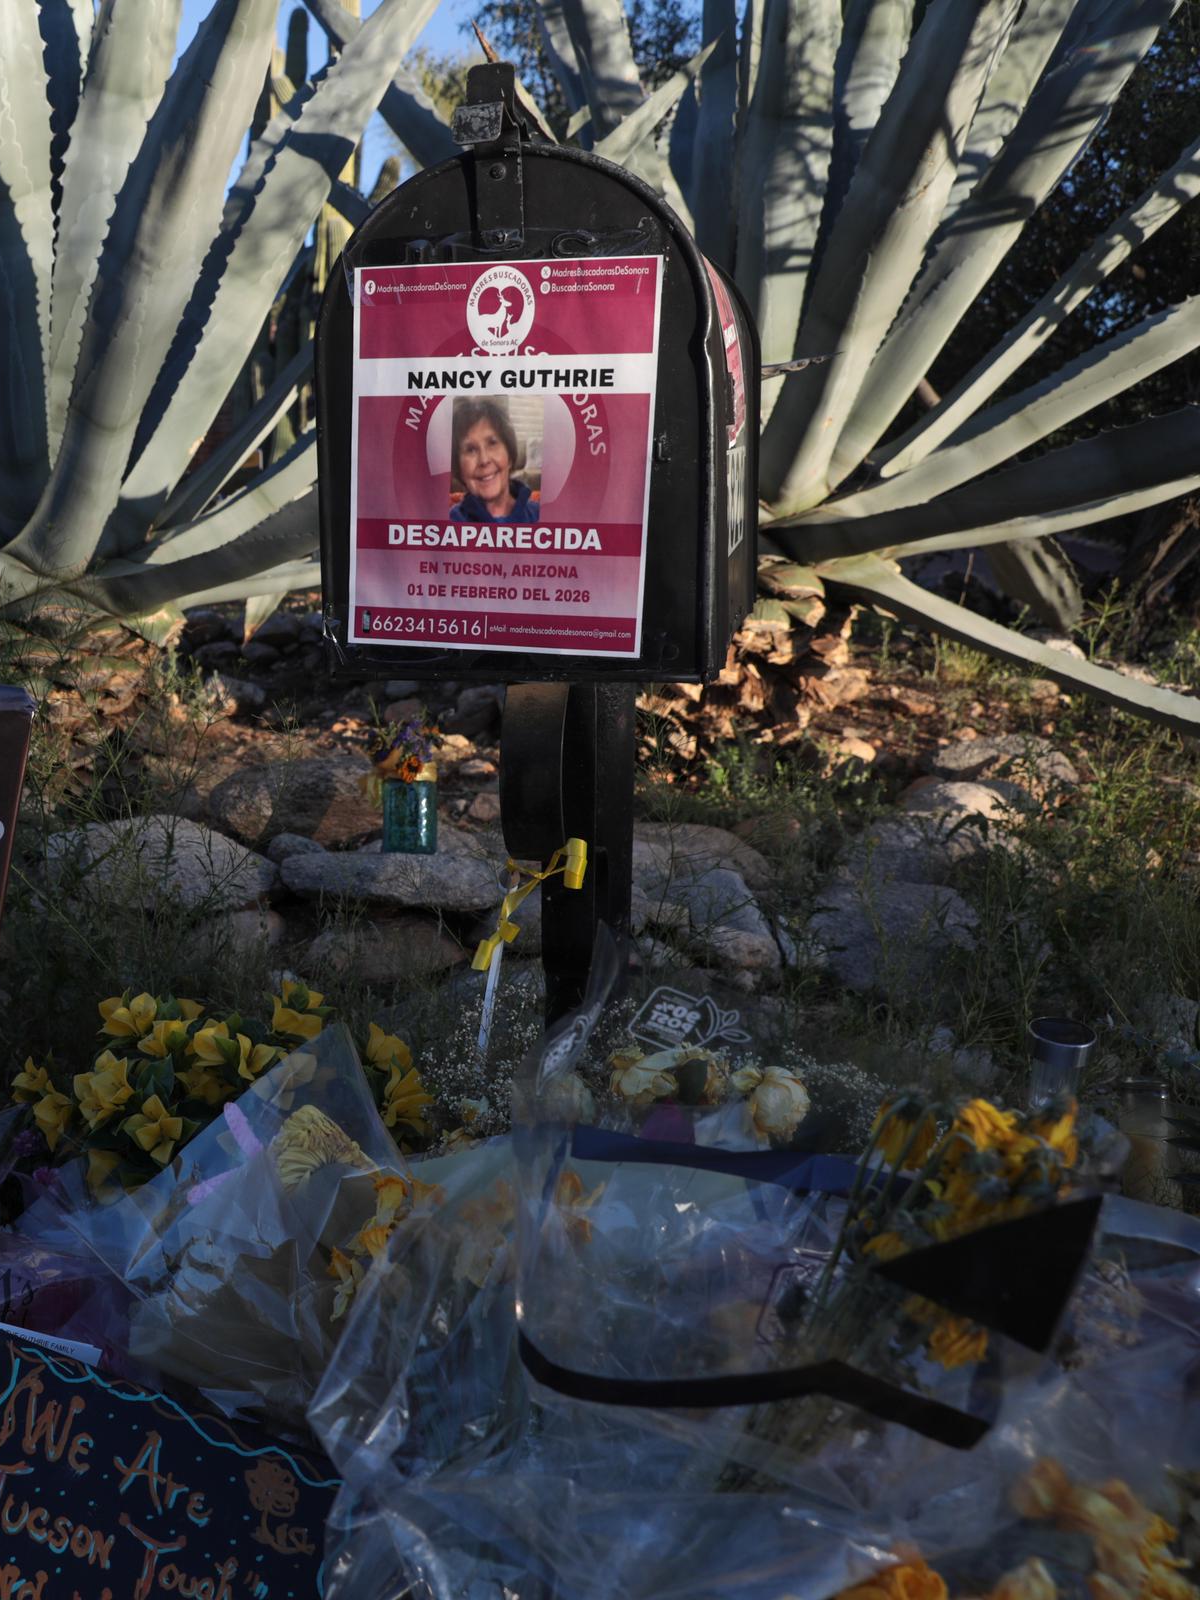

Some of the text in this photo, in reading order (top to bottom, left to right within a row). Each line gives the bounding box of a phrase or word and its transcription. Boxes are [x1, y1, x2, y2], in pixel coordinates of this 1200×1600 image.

[551, 281, 615, 293] BuscadoraSonora
[490, 339, 510, 347] Sonora
[407, 368, 615, 390] NANCY GUTHRIE
[388, 523, 602, 551] DESAPARECIDA
[419, 561, 578, 579] EN TUCSON, ARIZONA
[407, 583, 590, 603] 01 DE FEBRERO DEL 2026
[372, 615, 482, 636] 6623415616
[50, 1342, 76, 1354] FAMILY
